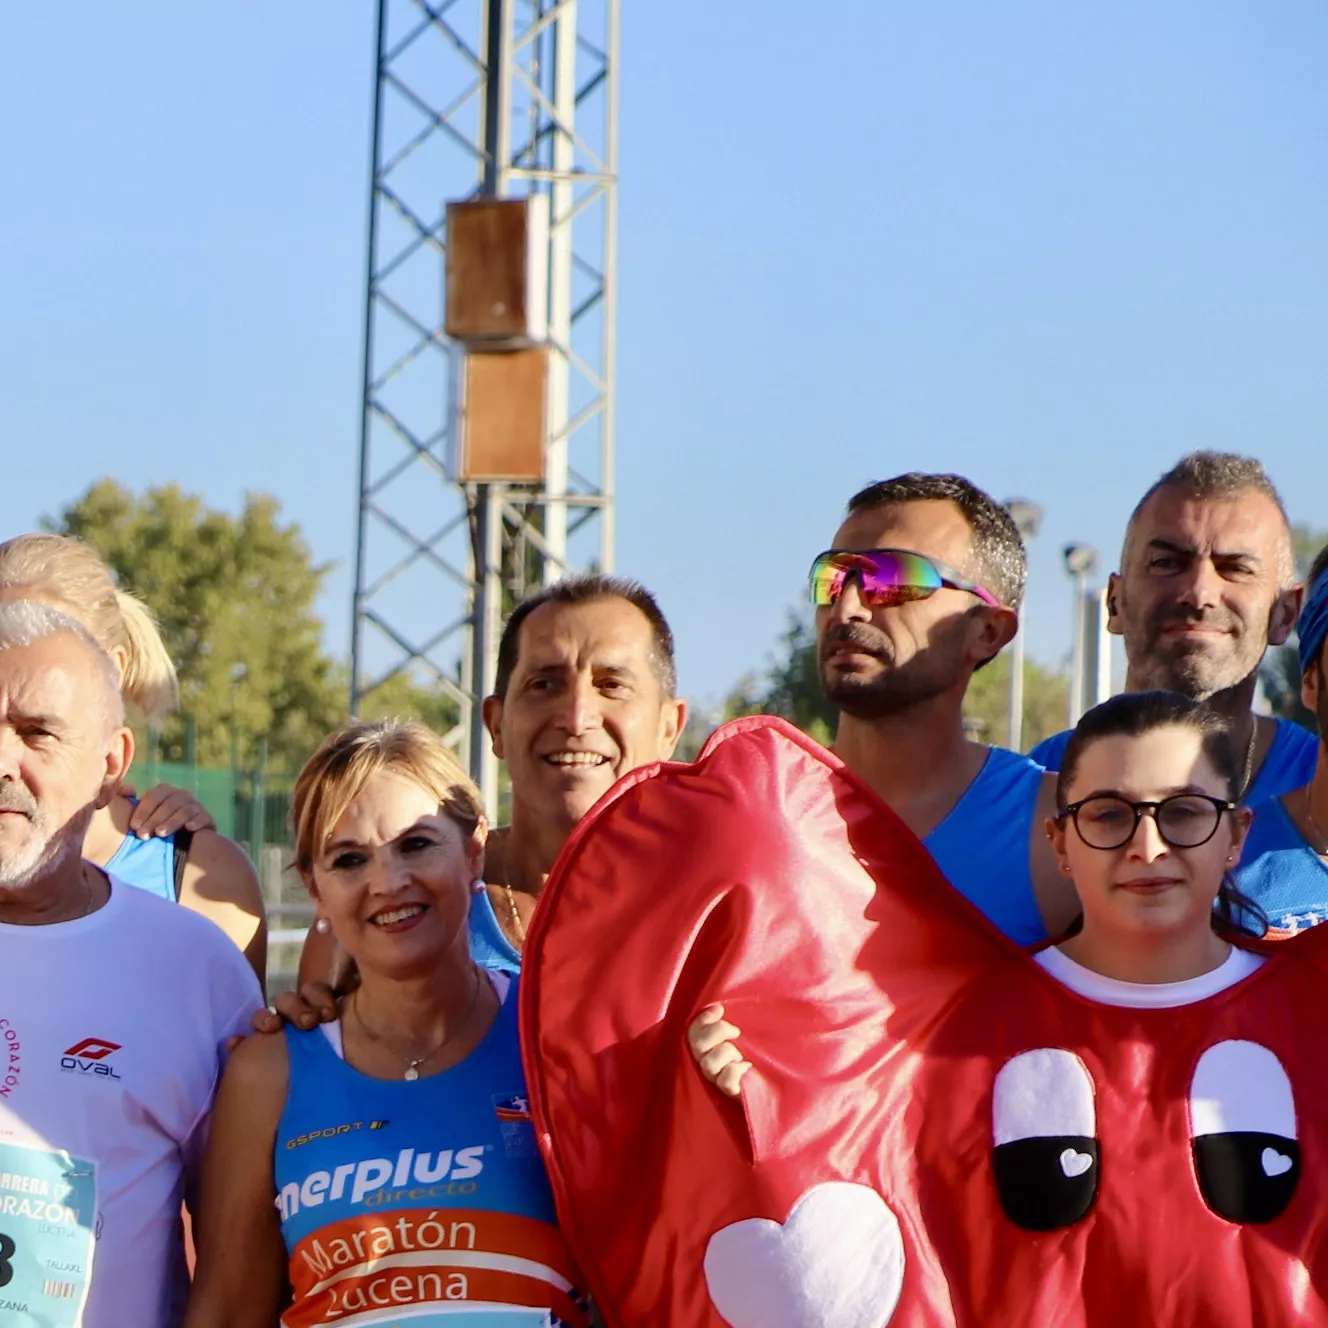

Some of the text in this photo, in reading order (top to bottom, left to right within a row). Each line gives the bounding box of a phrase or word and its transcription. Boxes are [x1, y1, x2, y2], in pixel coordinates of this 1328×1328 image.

[286, 1121, 365, 1150] GSPORT
[364, 1181, 478, 1207] directo
[301, 1211, 476, 1278] Maratón
